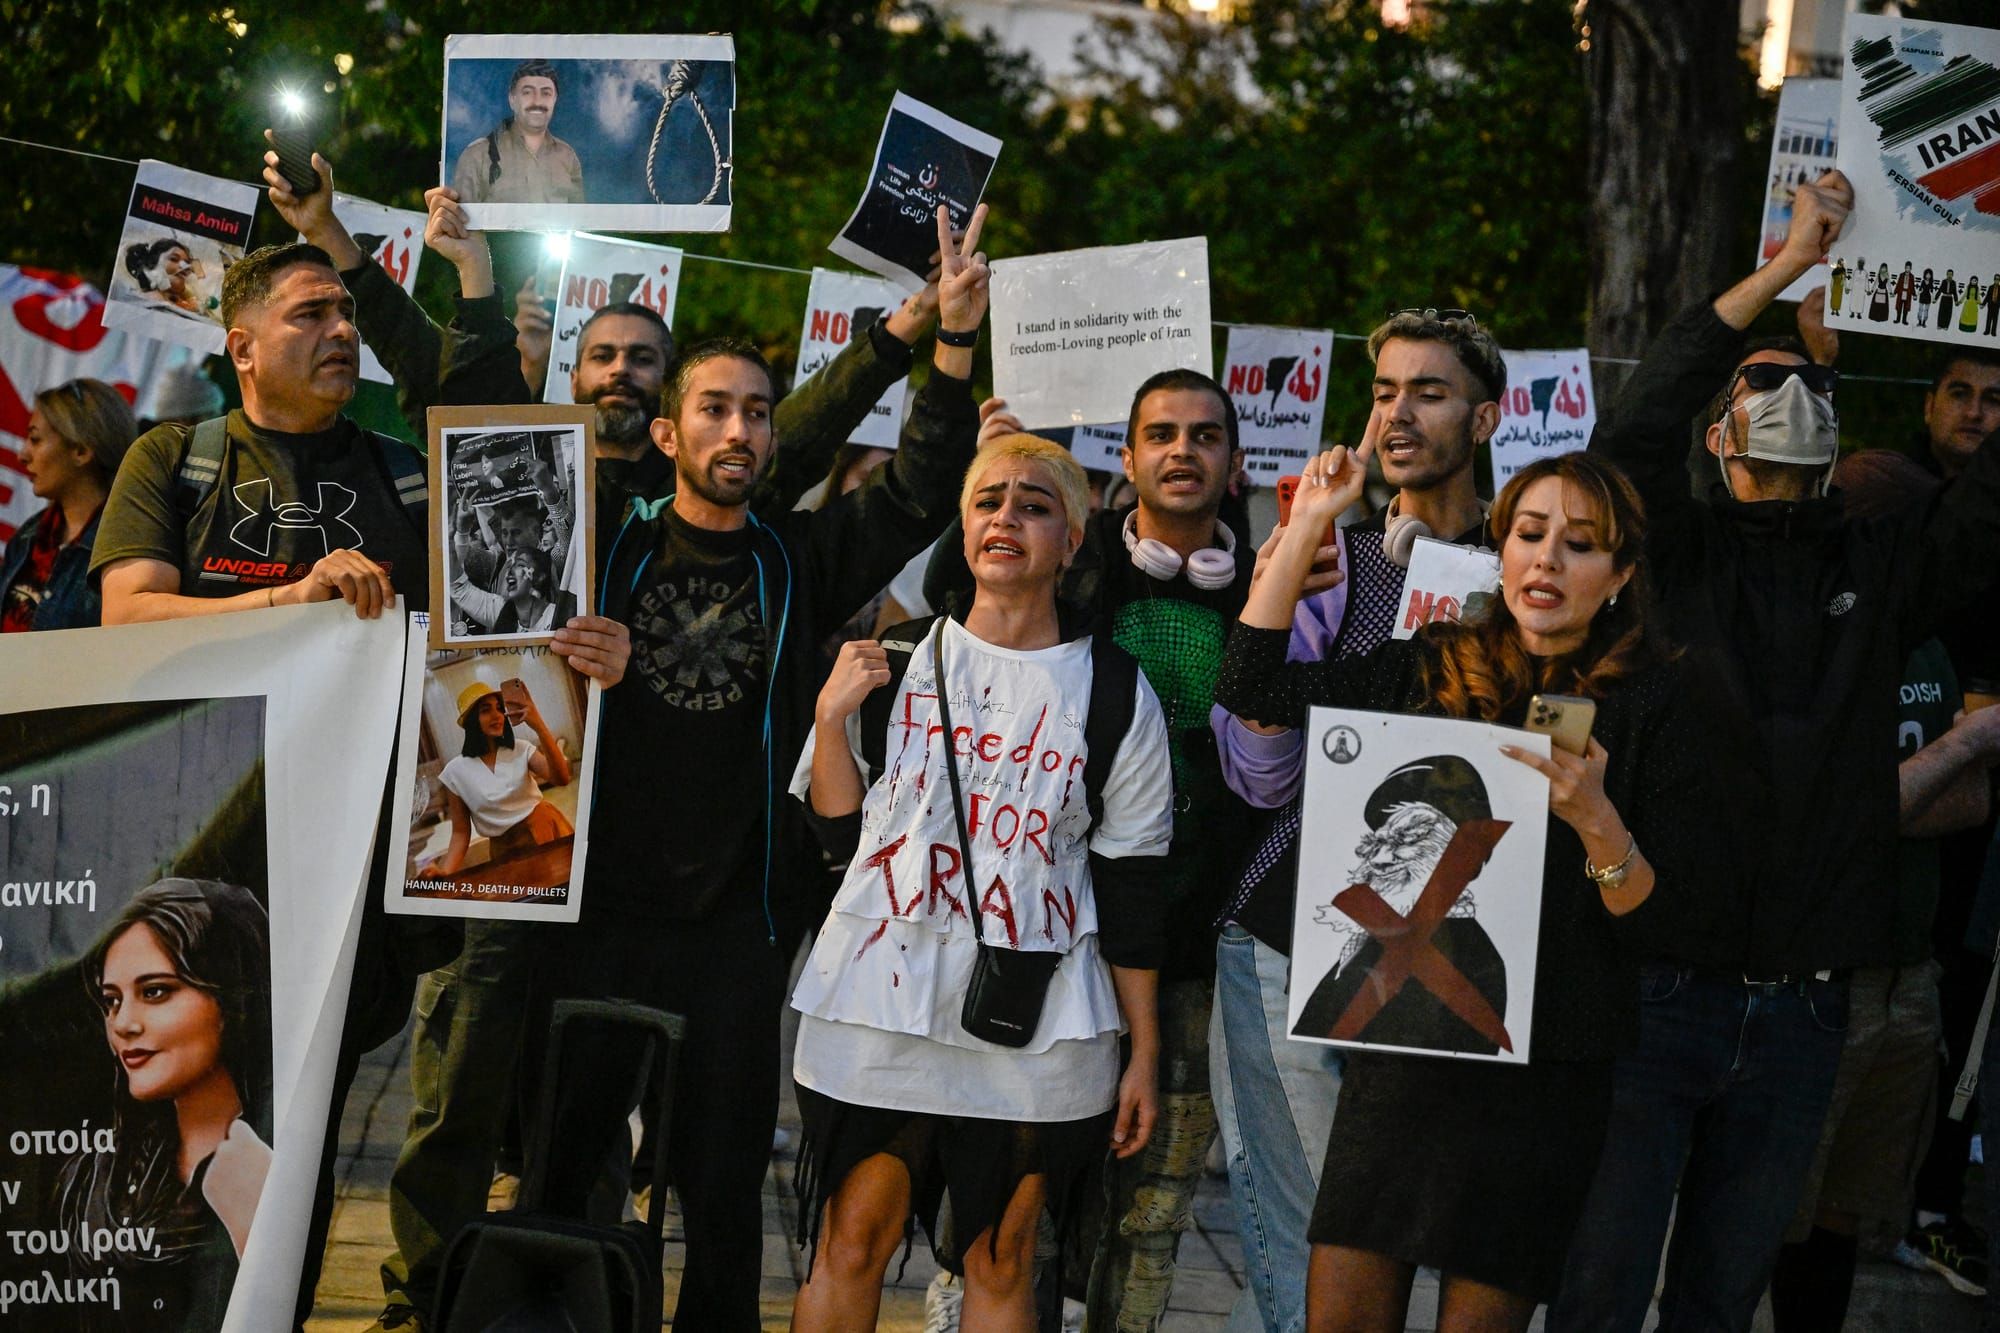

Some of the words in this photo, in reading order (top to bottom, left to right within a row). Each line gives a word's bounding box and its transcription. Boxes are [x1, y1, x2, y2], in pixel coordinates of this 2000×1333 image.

[1901, 46, 1931, 55] CASPIAN
[1931, 49, 1944, 57] SEA
[1917, 108, 2000, 169] IRAN
[879, 180, 905, 200] Freedom
[889, 175, 901, 186] Life
[1887, 169, 1933, 207] PERSIAN
[1933, 202, 1961, 227] GULF
[142, 195, 191, 222] Mahsa
[194, 212, 240, 235] Amini
[565, 274, 608, 312] NO
[810, 309, 849, 345] NO
[1016, 322, 1021, 335] I
[1025, 318, 1056, 334] stand
[1059, 317, 1071, 330] in
[1073, 312, 1129, 330] solidarity
[1132, 307, 1159, 322] with
[1162, 305, 1182, 319] the
[1009, 334, 1104, 356] freedom-Loving
[1107, 328, 1147, 348] people
[1150, 326, 1164, 340] of
[1166, 325, 1192, 340] Iran
[559, 362, 571, 373] TO
[1228, 364, 1265, 396] NO
[203, 556, 288, 577] UNDER
[633, 582, 678, 632] RED
[687, 576, 731, 600] HO
[1404, 589, 1461, 630] NO
[1900, 682, 1942, 705] DISH
[31, 783, 50, 816] η
[968, 793, 1055, 866] FOR
[405, 880, 458, 893] HANANEH,
[461, 883, 476, 894] 23,
[477, 884, 510, 895] DEATH
[512, 885, 526, 895] BY
[527, 887, 567, 897] BULLETS
[857, 834, 1076, 951] IRAN
[9, 1119, 116, 1155] οποία
[0, 1180, 21, 1213] ν
[6, 1230, 70, 1255] του
[81, 1217, 161, 1261] Ιράν,
